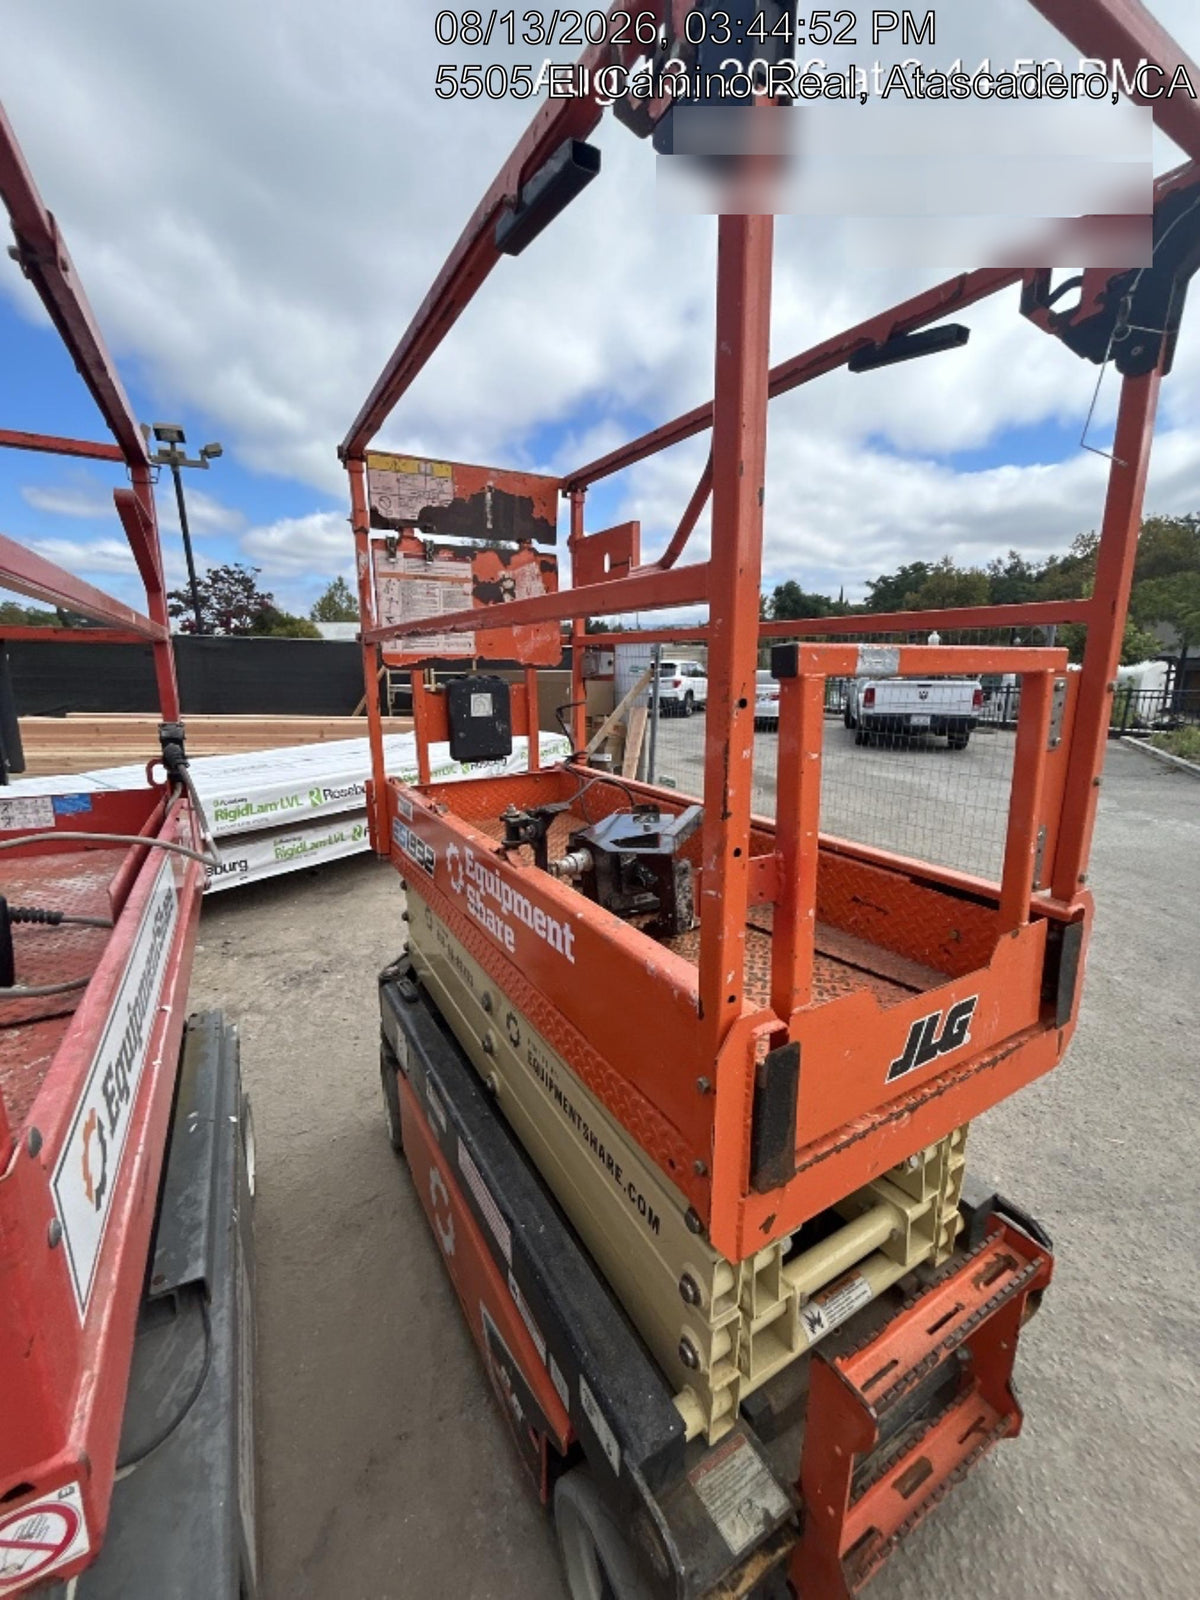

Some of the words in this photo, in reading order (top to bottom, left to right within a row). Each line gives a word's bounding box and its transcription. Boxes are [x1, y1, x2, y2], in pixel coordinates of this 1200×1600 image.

[464, 845, 575, 964] Equipment
[466, 883, 516, 953] Share
[885, 994, 979, 1084] JLG
[527, 1049, 661, 1236] EQUIPMENTSHARE.COM
